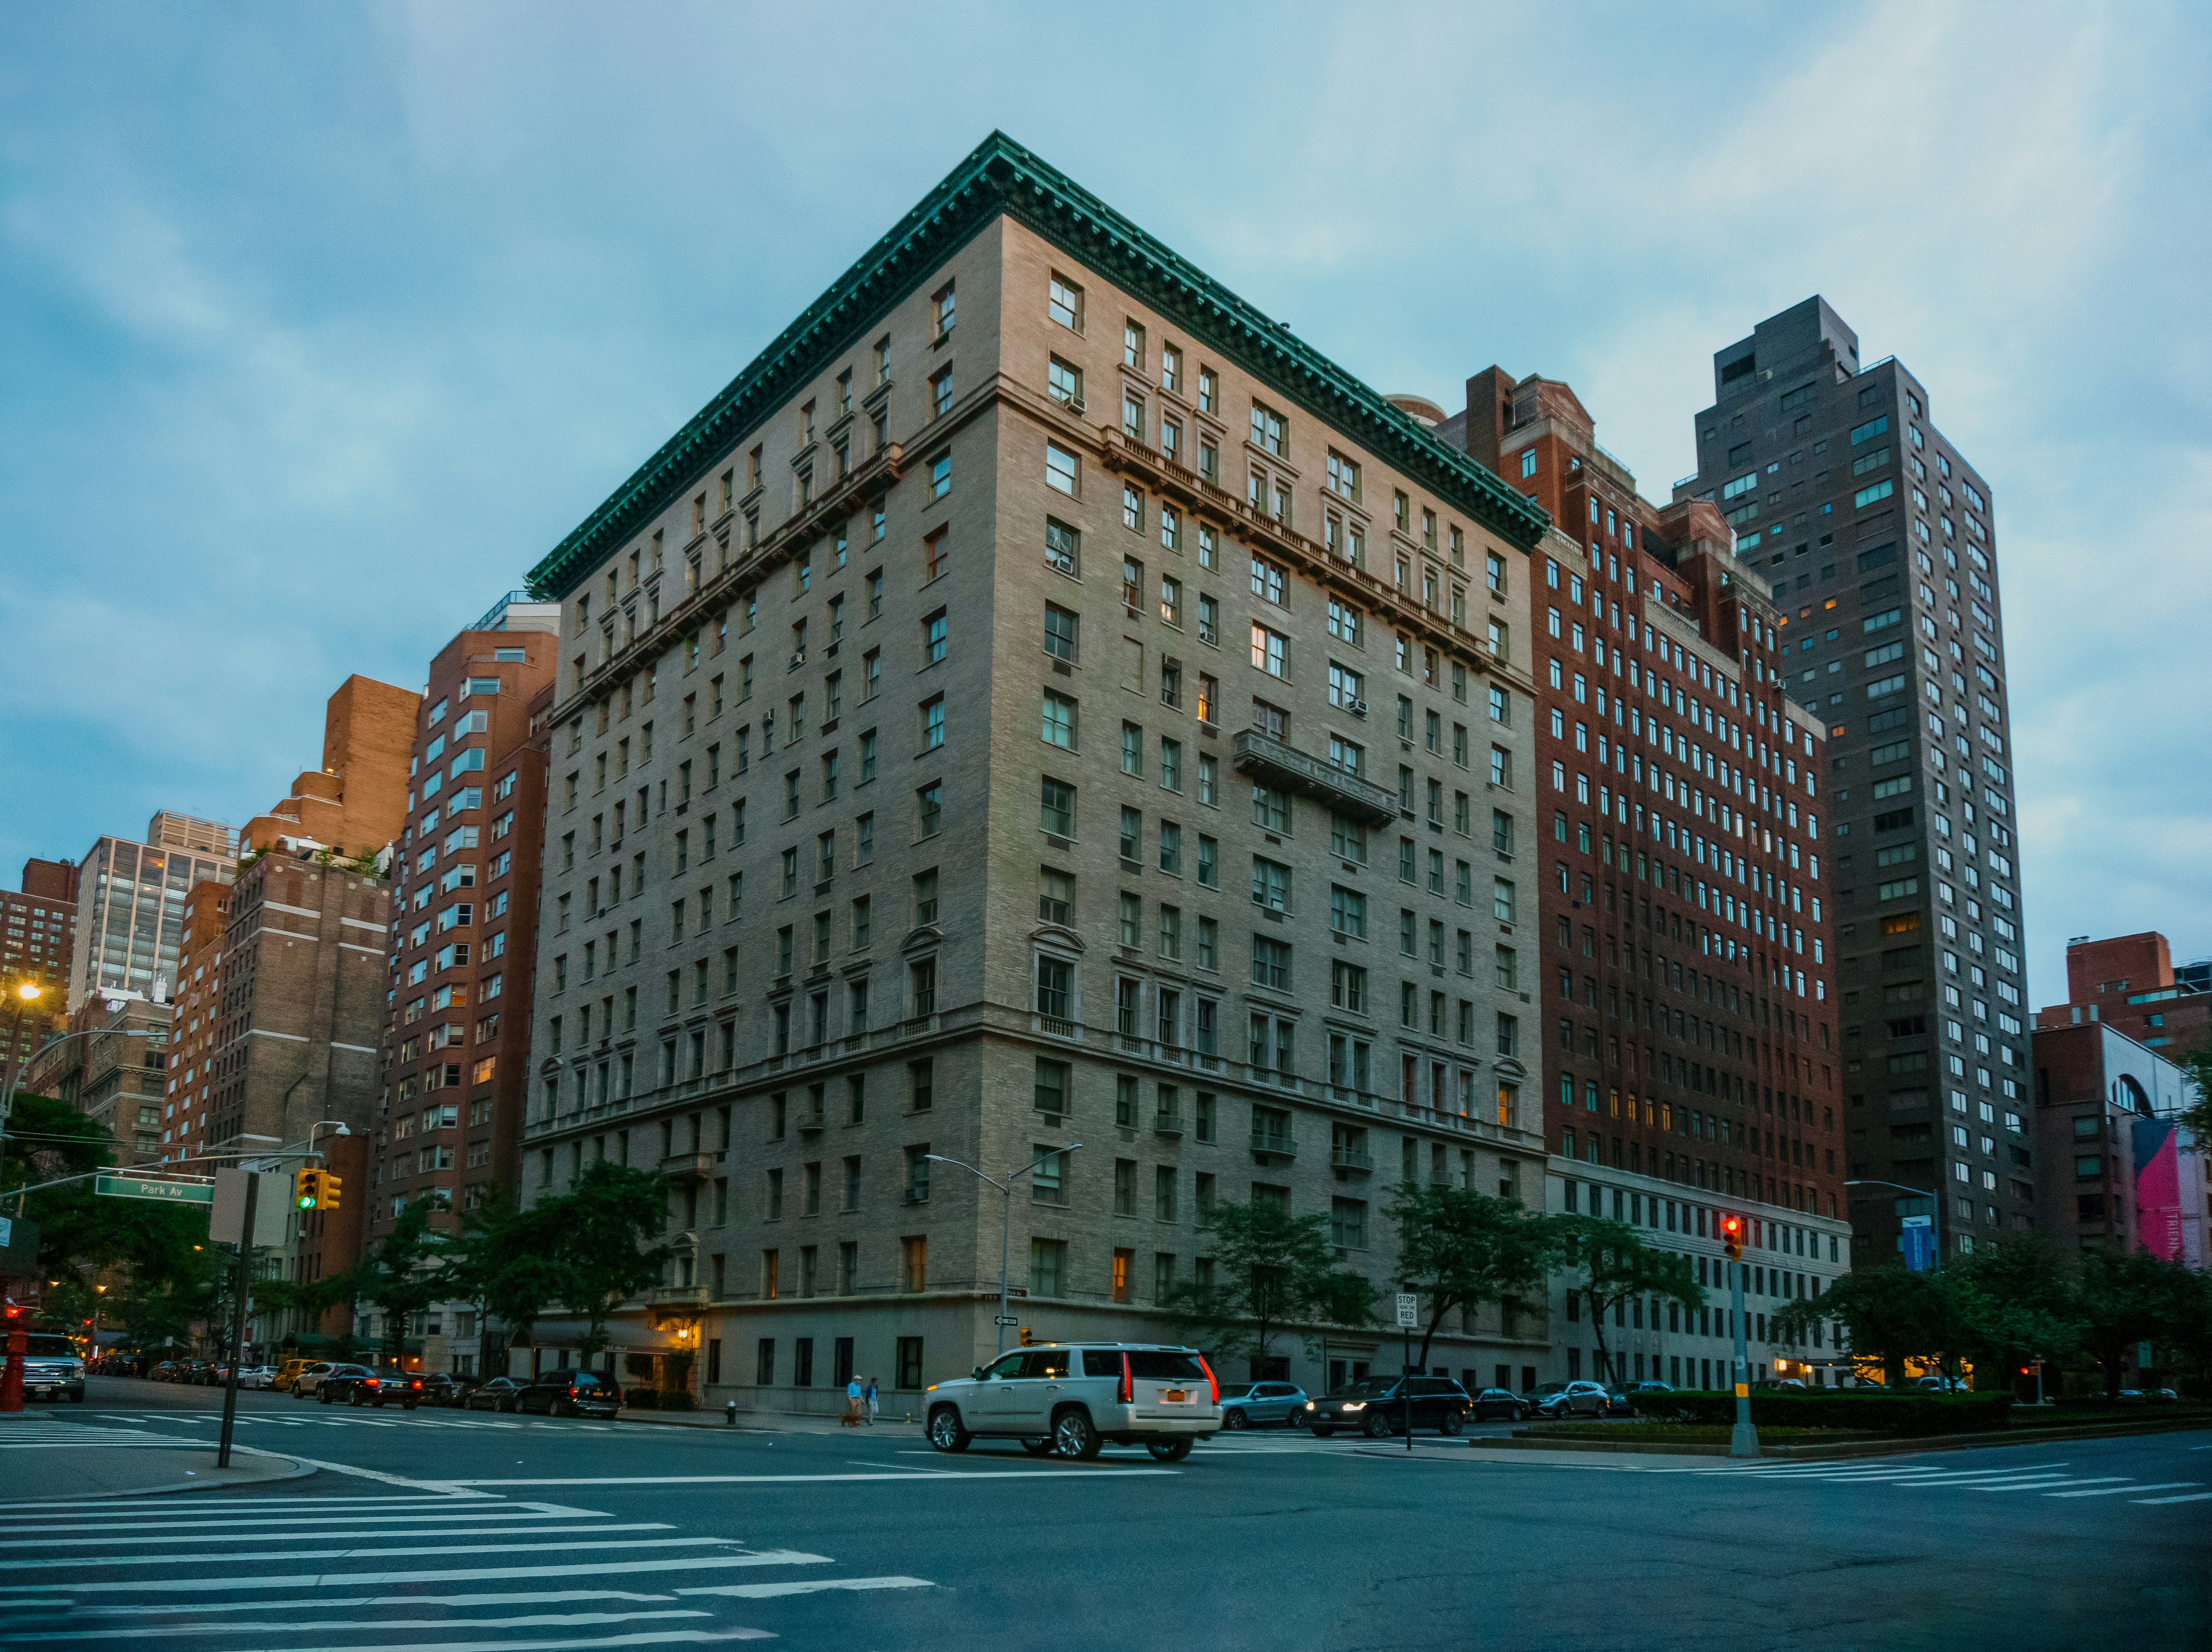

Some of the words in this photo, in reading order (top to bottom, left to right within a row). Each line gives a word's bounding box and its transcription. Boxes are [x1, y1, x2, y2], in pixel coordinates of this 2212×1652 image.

[141, 1184, 165, 1195] Park
[170, 1187, 183, 1196] Av
[1398, 1295, 1415, 1304] STOP
